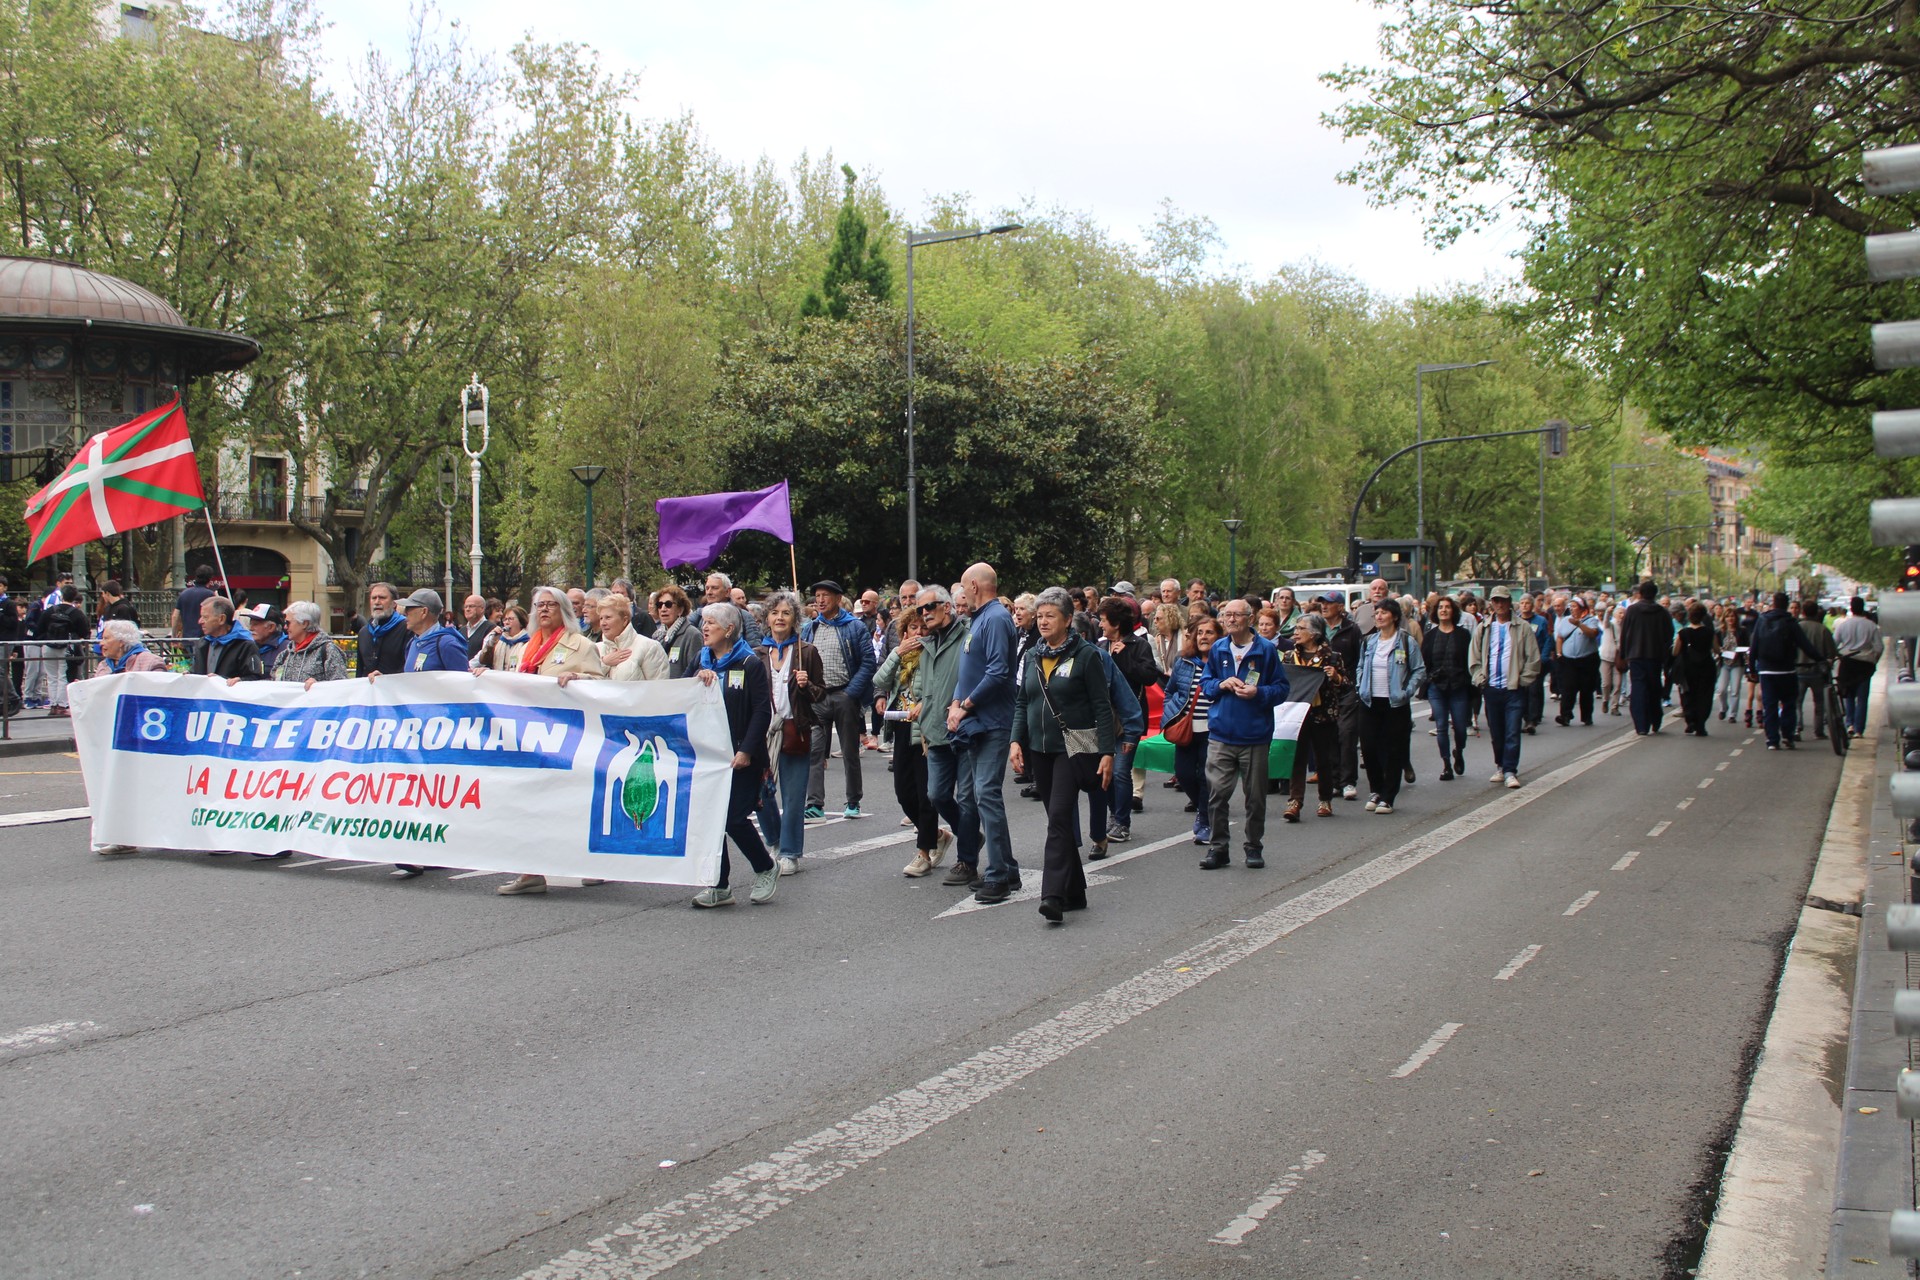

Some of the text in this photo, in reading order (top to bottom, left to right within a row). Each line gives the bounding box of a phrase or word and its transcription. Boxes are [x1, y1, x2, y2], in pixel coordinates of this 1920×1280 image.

[140, 708, 568, 753] 8 URTE BORROKAN
[186, 764, 481, 810] LA LUCHA CONTINUA
[298, 810, 450, 843] PENTSIODUNAK
